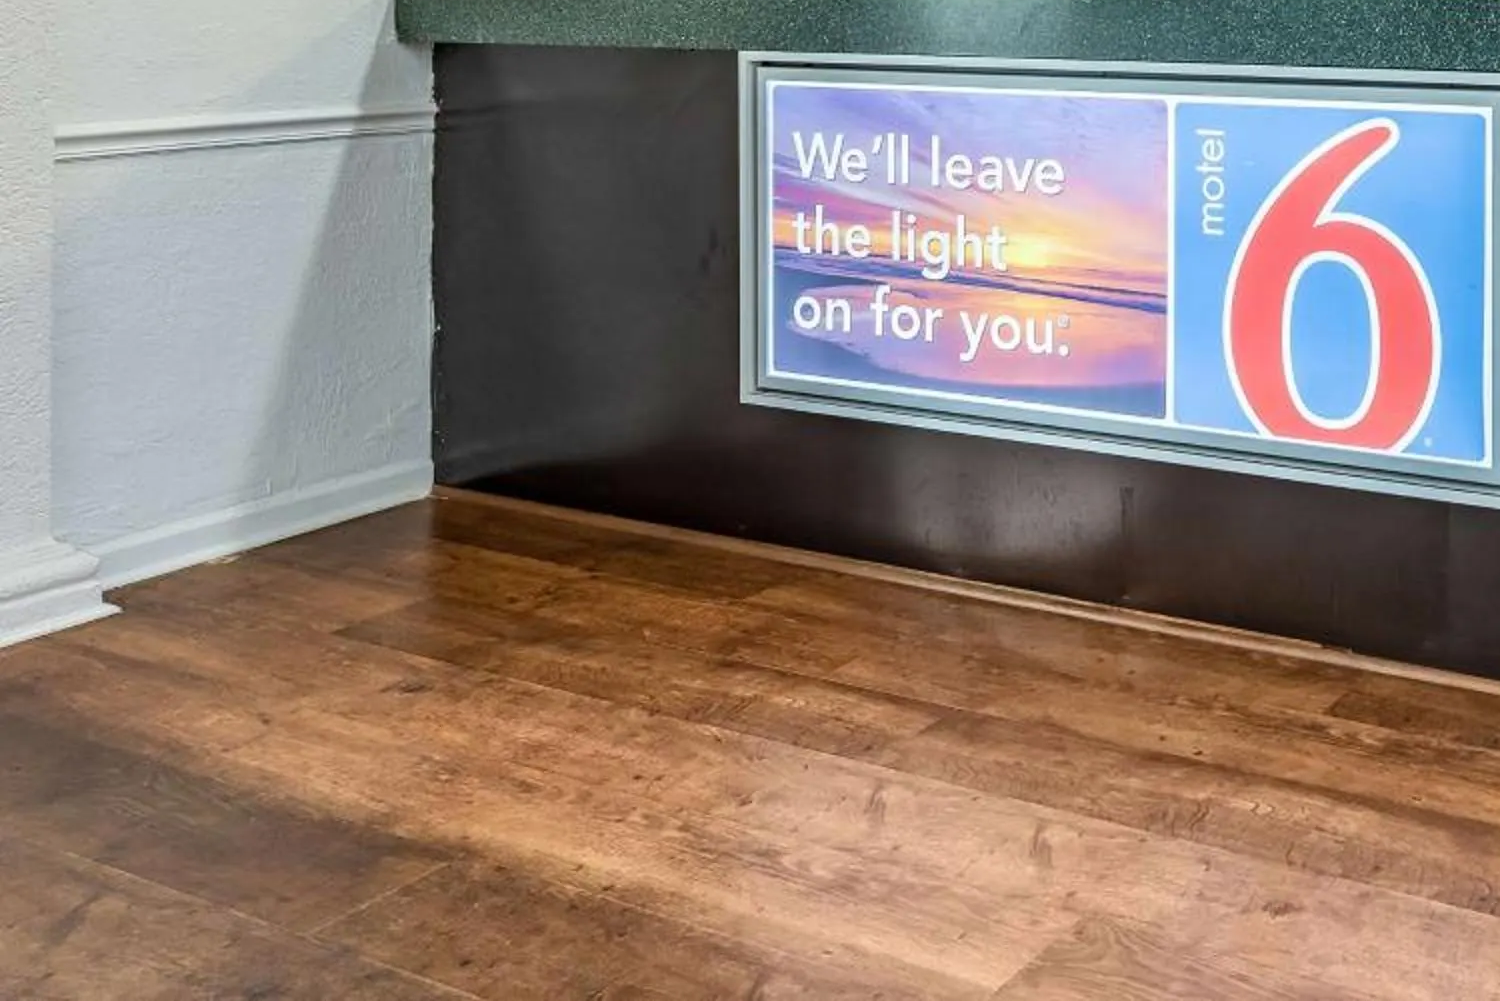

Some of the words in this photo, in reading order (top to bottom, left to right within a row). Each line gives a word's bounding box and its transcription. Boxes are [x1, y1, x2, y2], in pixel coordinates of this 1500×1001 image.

[792, 131, 909, 184] We’ll
[931, 134, 1065, 194] leave
[792, 204, 872, 258] the
[892, 210, 1008, 280] light
[793, 295, 851, 332] on
[870, 285, 944, 342] for
[1196, 128, 1225, 236] motel
[1222, 117, 1442, 453] 6
